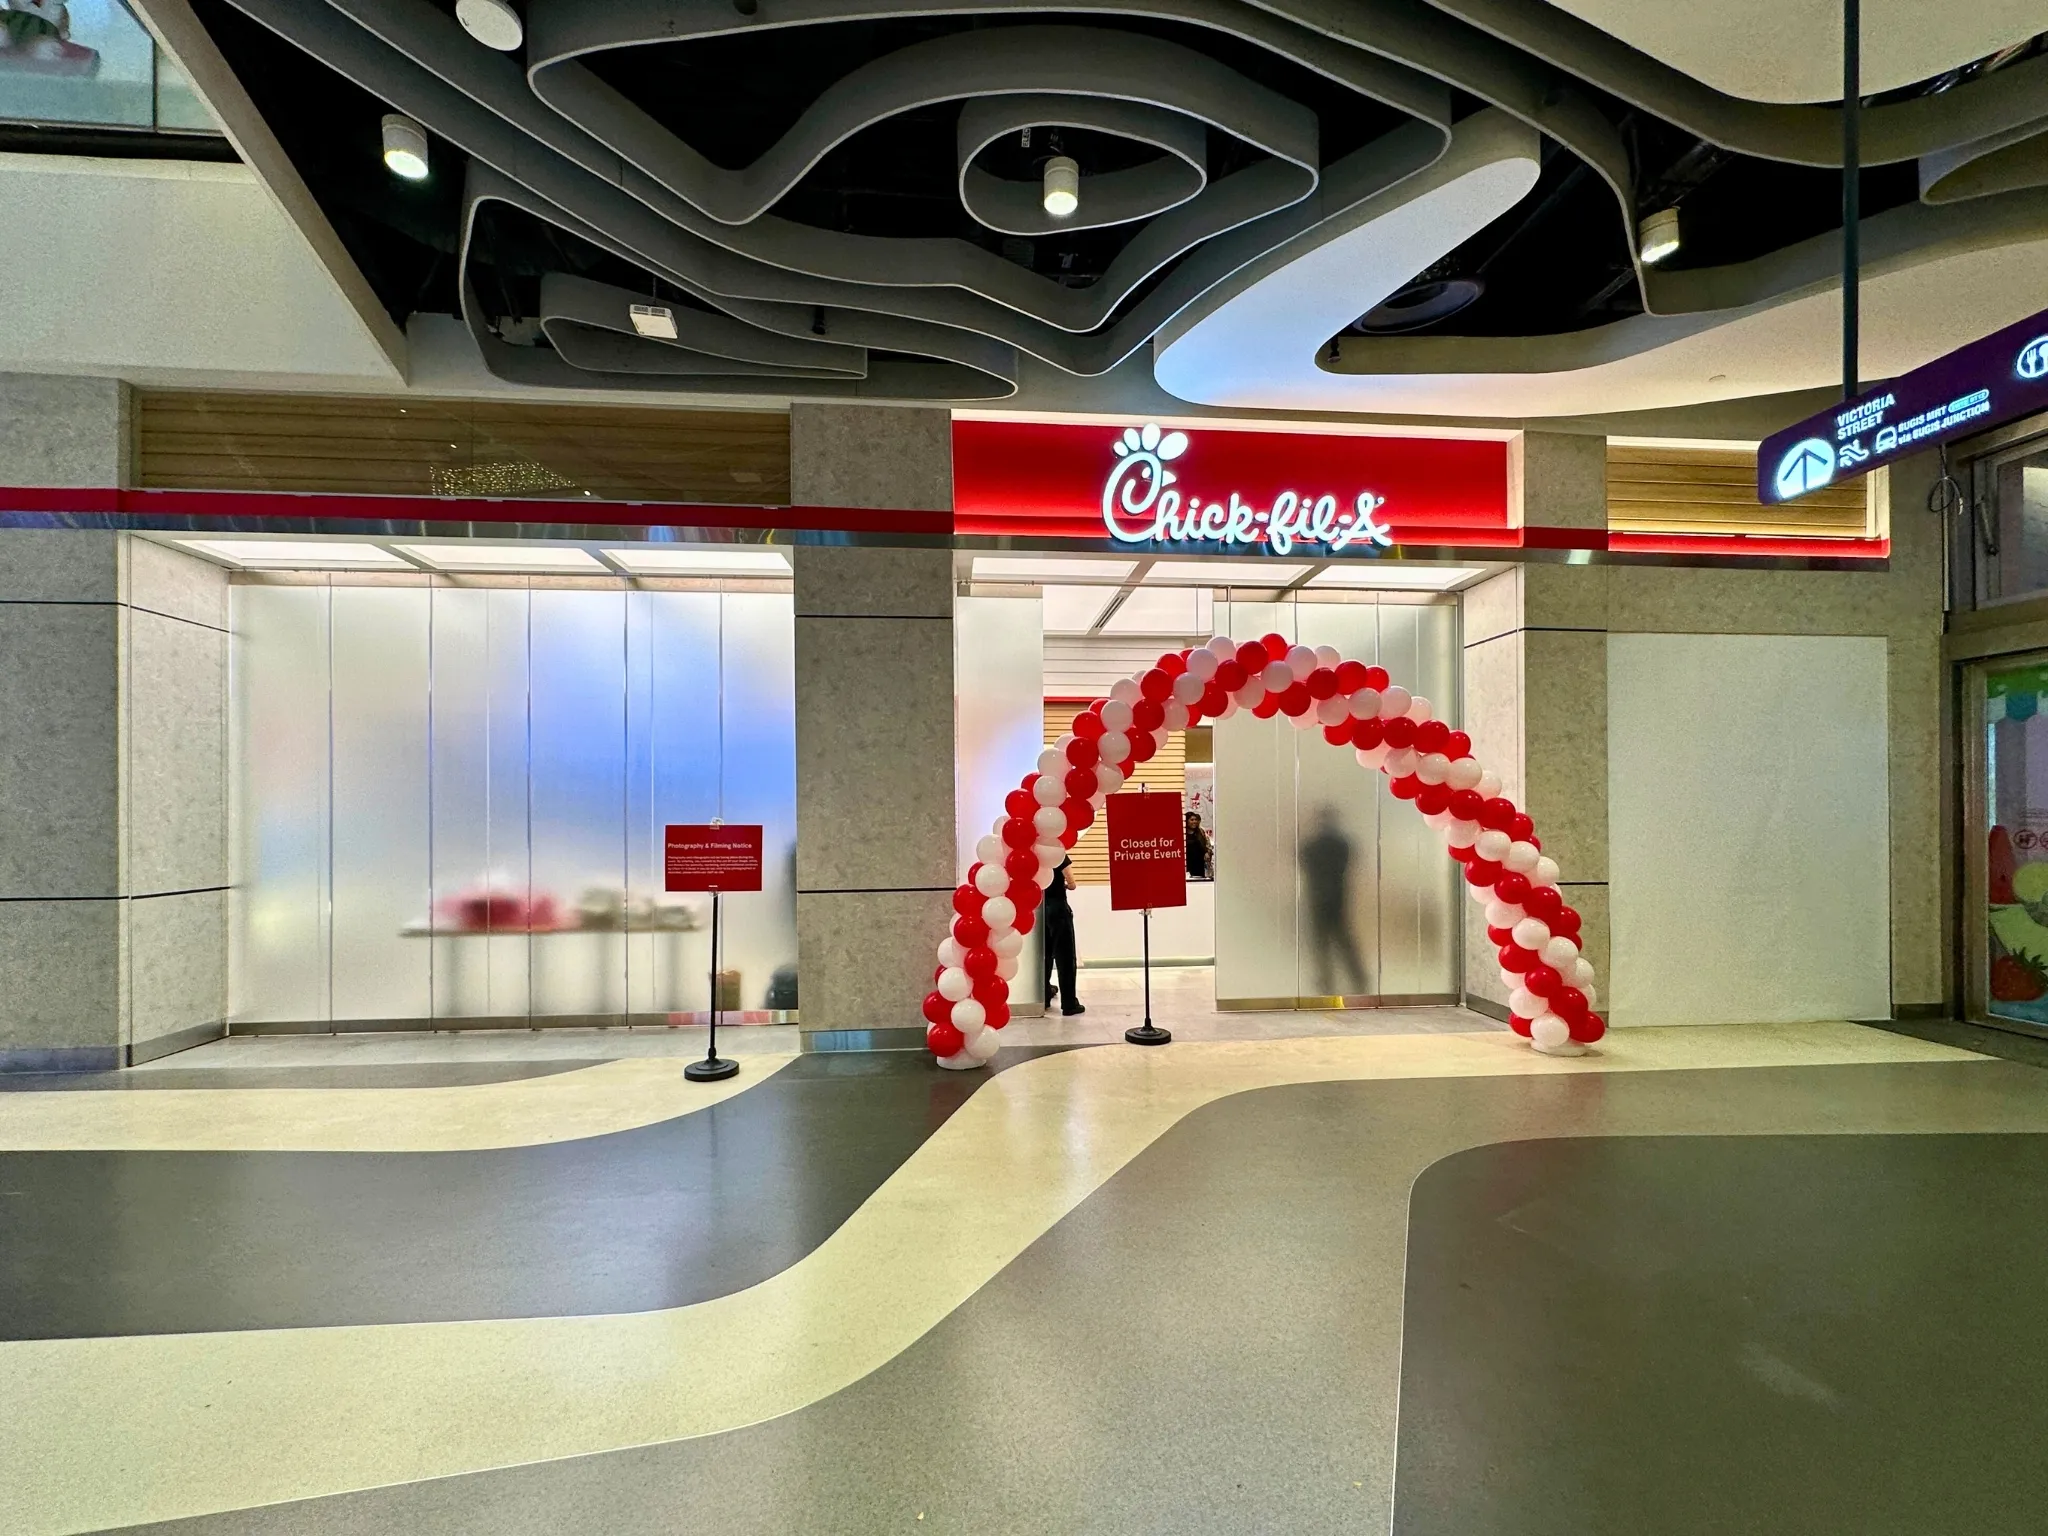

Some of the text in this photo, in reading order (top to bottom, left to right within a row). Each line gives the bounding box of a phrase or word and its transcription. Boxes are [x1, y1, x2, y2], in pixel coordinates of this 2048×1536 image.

[1837, 393, 1895, 427] VICTORIA
[1898, 405, 1947, 433] BUGIS MRT
[1912, 420, 1941, 440] BUGIS
[1940, 401, 1991, 428] JUNCTION
[1837, 410, 1884, 440] STREET
[1102, 450, 1393, 556] Chick-fil-A
[667, 842, 704, 850] Photography
[710, 842, 732, 850] Filming
[1114, 848, 1182, 861] Private Event
[1120, 837, 1174, 849] Closed for
